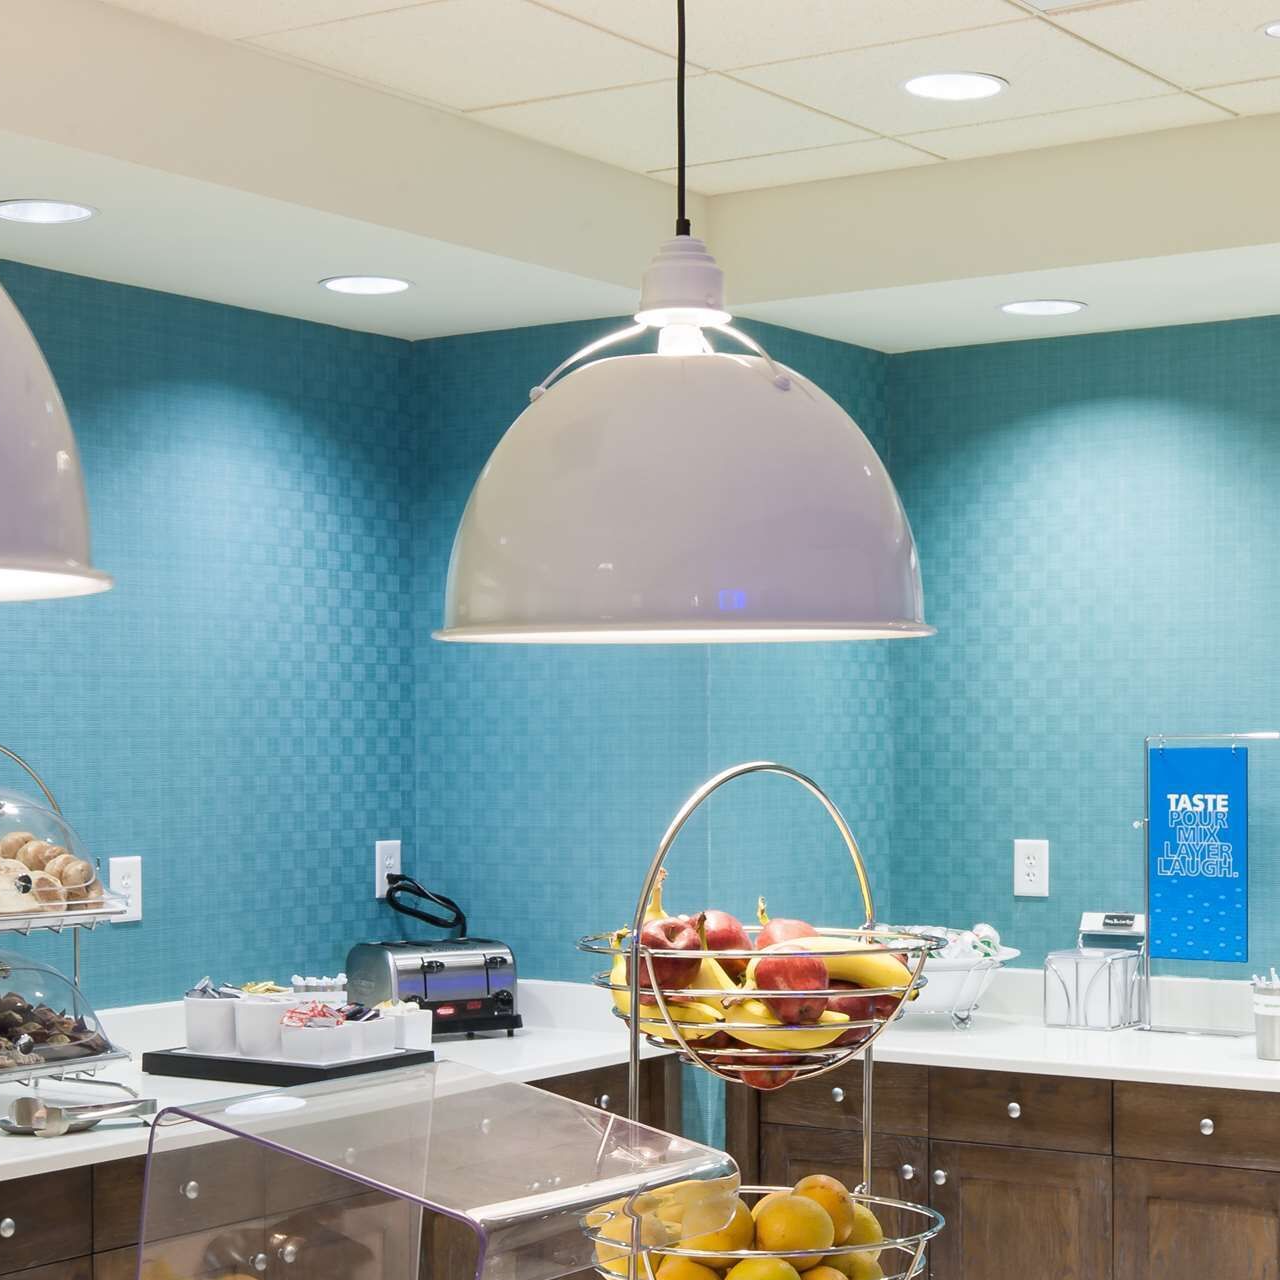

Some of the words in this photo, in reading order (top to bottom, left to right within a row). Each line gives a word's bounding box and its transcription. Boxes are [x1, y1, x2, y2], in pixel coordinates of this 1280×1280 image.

[1167, 794, 1229, 811] TASTE
[1169, 810, 1228, 828] POUR
[1177, 826, 1220, 844] MIX
[1164, 842, 1232, 860] LAYER
[1158, 858, 1239, 878] LAUGH.
